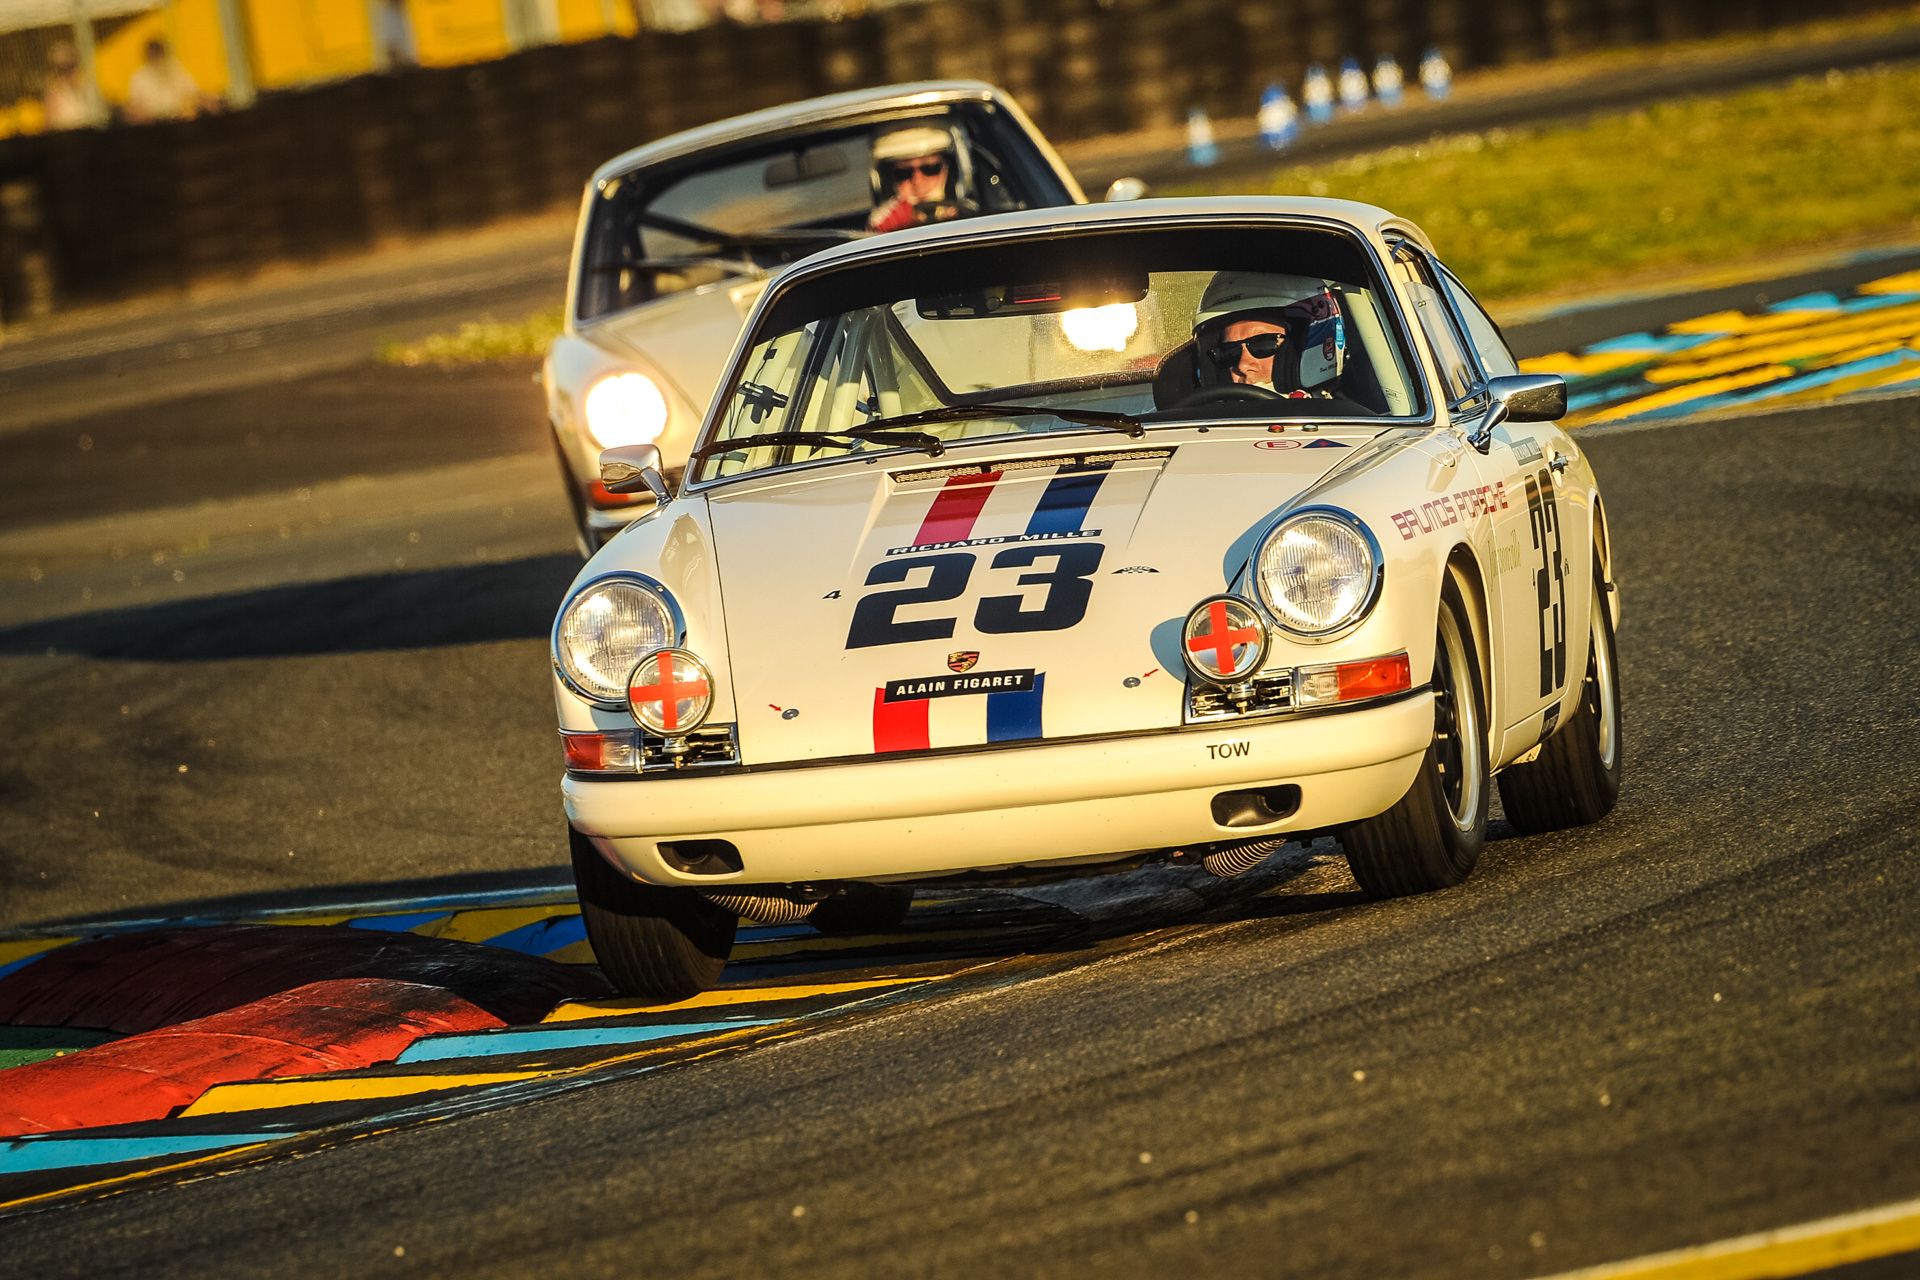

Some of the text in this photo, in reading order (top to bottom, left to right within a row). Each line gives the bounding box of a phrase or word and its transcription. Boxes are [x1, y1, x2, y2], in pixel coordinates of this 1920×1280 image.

[1266, 441, 1289, 449] E
[1390, 481, 1509, 541] BRUMOS PORSCHE
[892, 529, 1097, 556] RICHARD MILLE
[821, 589, 842, 600] 4
[1524, 466, 1566, 699] 23
[845, 541, 1106, 651] 23
[896, 674, 1024, 696] ALAIN FIGARET
[1206, 741, 1250, 760] TOW
